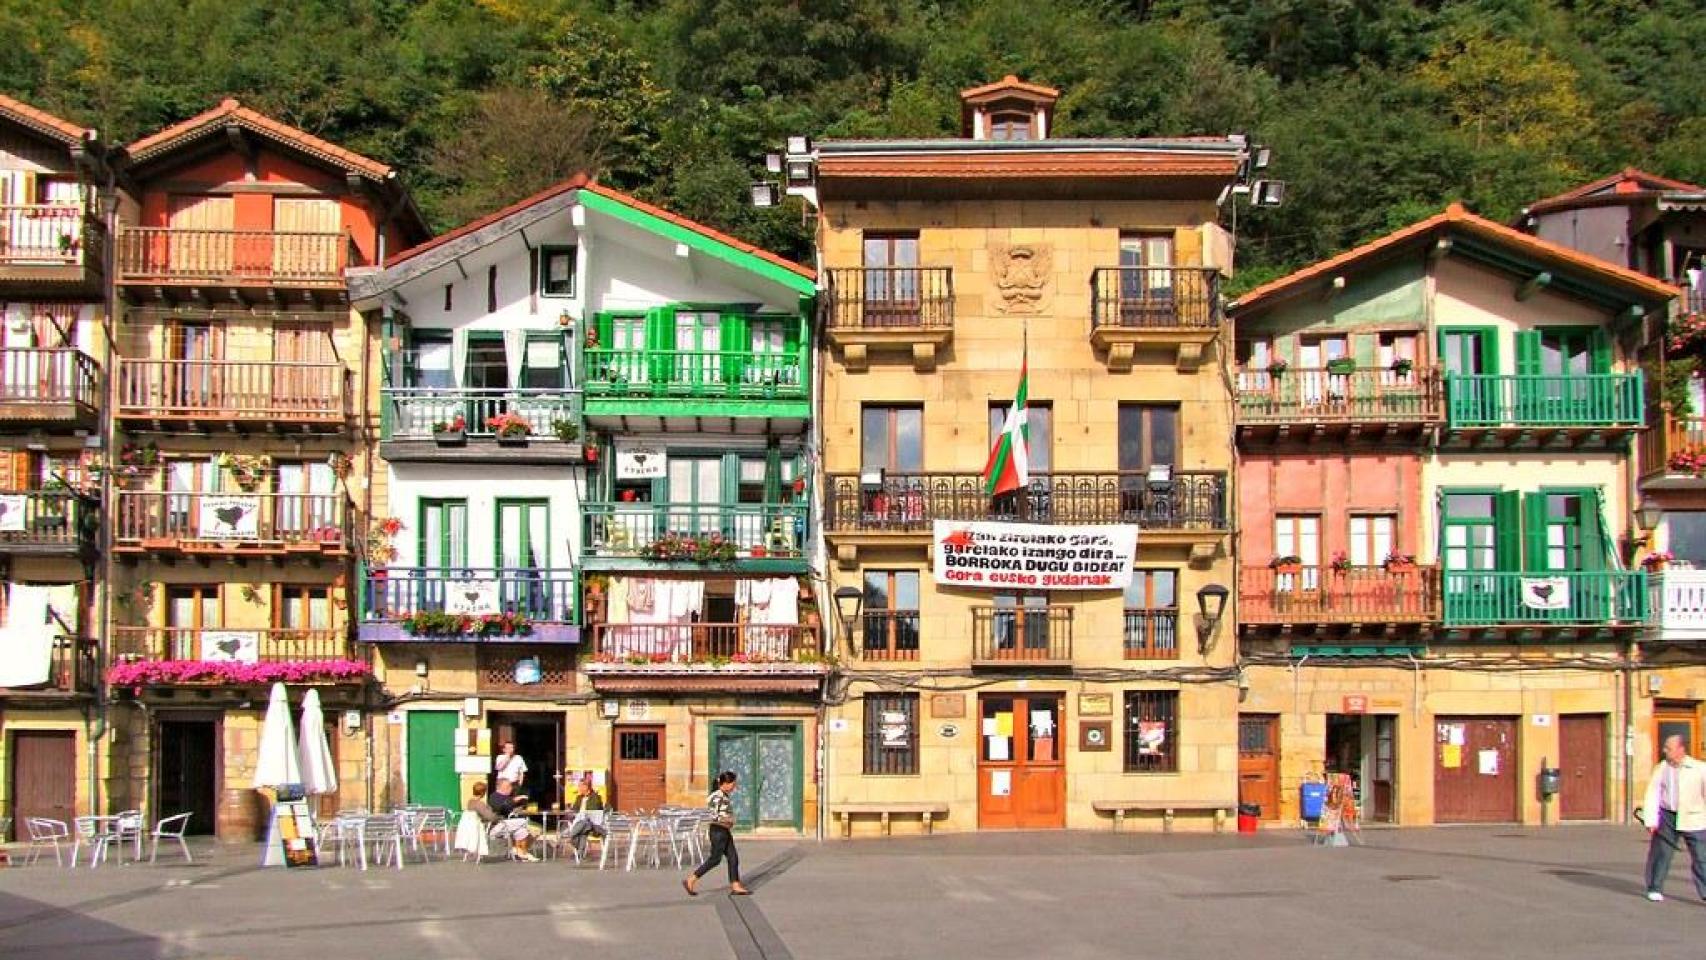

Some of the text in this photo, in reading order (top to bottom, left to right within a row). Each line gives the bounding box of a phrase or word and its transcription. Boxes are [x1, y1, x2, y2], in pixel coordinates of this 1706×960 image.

[944, 544, 1019, 556] garelako
[1022, 546, 1077, 560] izango
[945, 554, 1125, 573] BORROKA DUGU BIDEA!
[946, 569, 983, 581] Gora
[989, 572, 1037, 585] eusko
